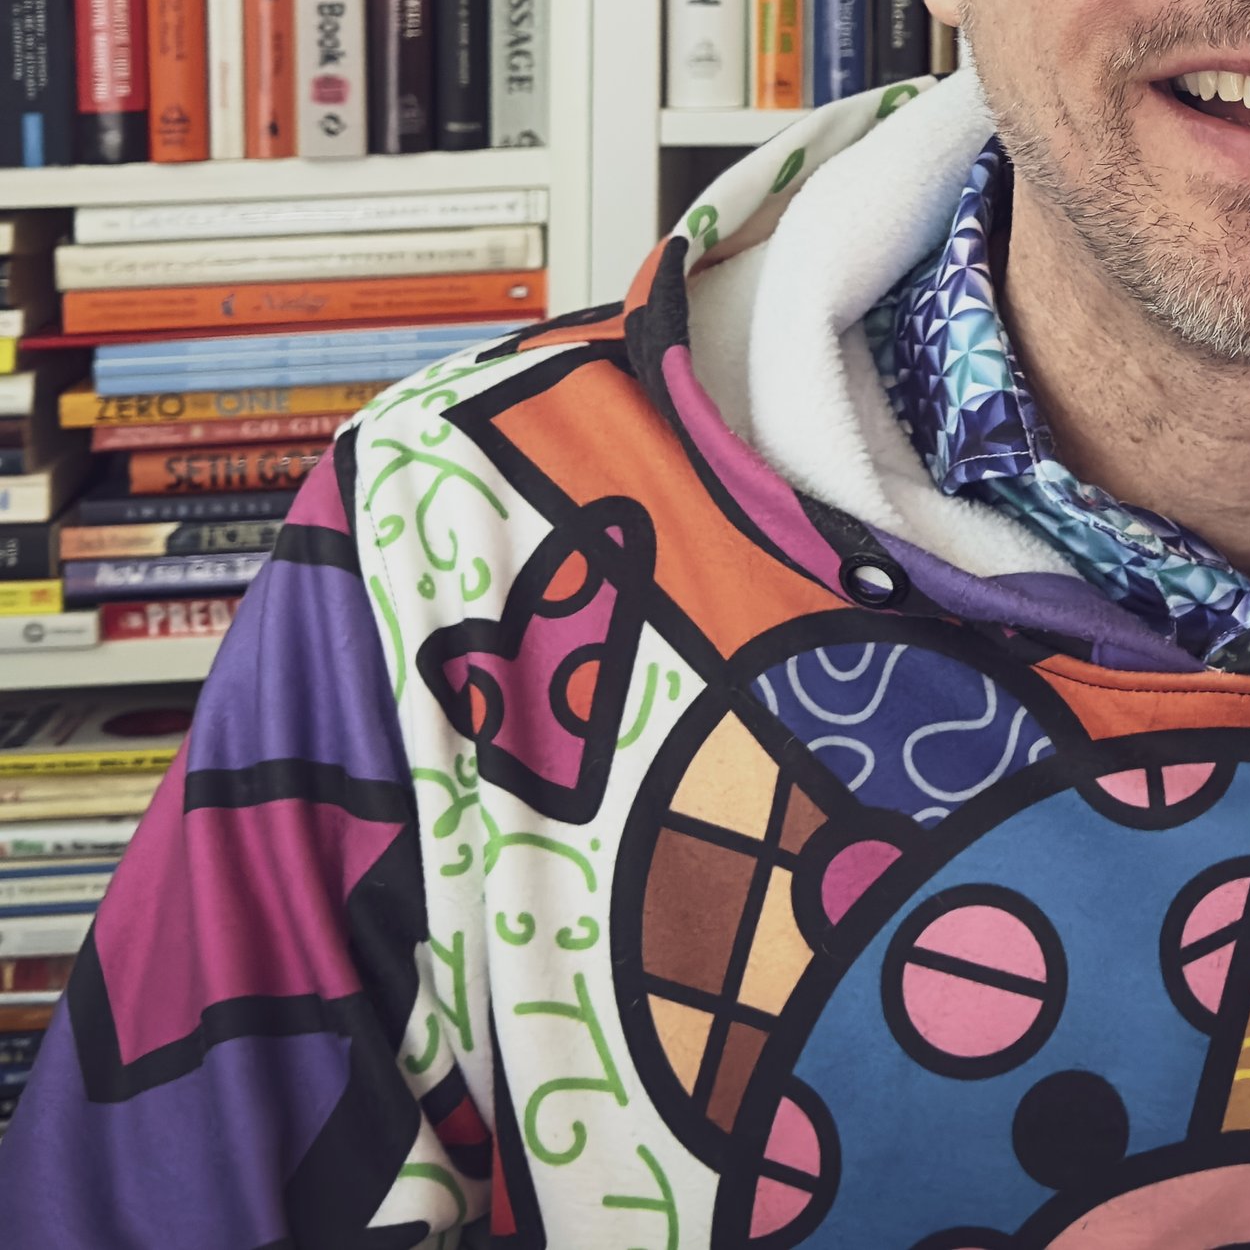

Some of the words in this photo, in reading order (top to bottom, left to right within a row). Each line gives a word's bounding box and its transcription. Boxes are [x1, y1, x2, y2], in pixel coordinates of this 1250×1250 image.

[317, 2, 346, 68] Book
[97, 392, 186, 424] ZERO
[214, 389, 291, 420] ONE
[164, 451, 248, 492] SETH
[256, 445, 325, 487] GOD
